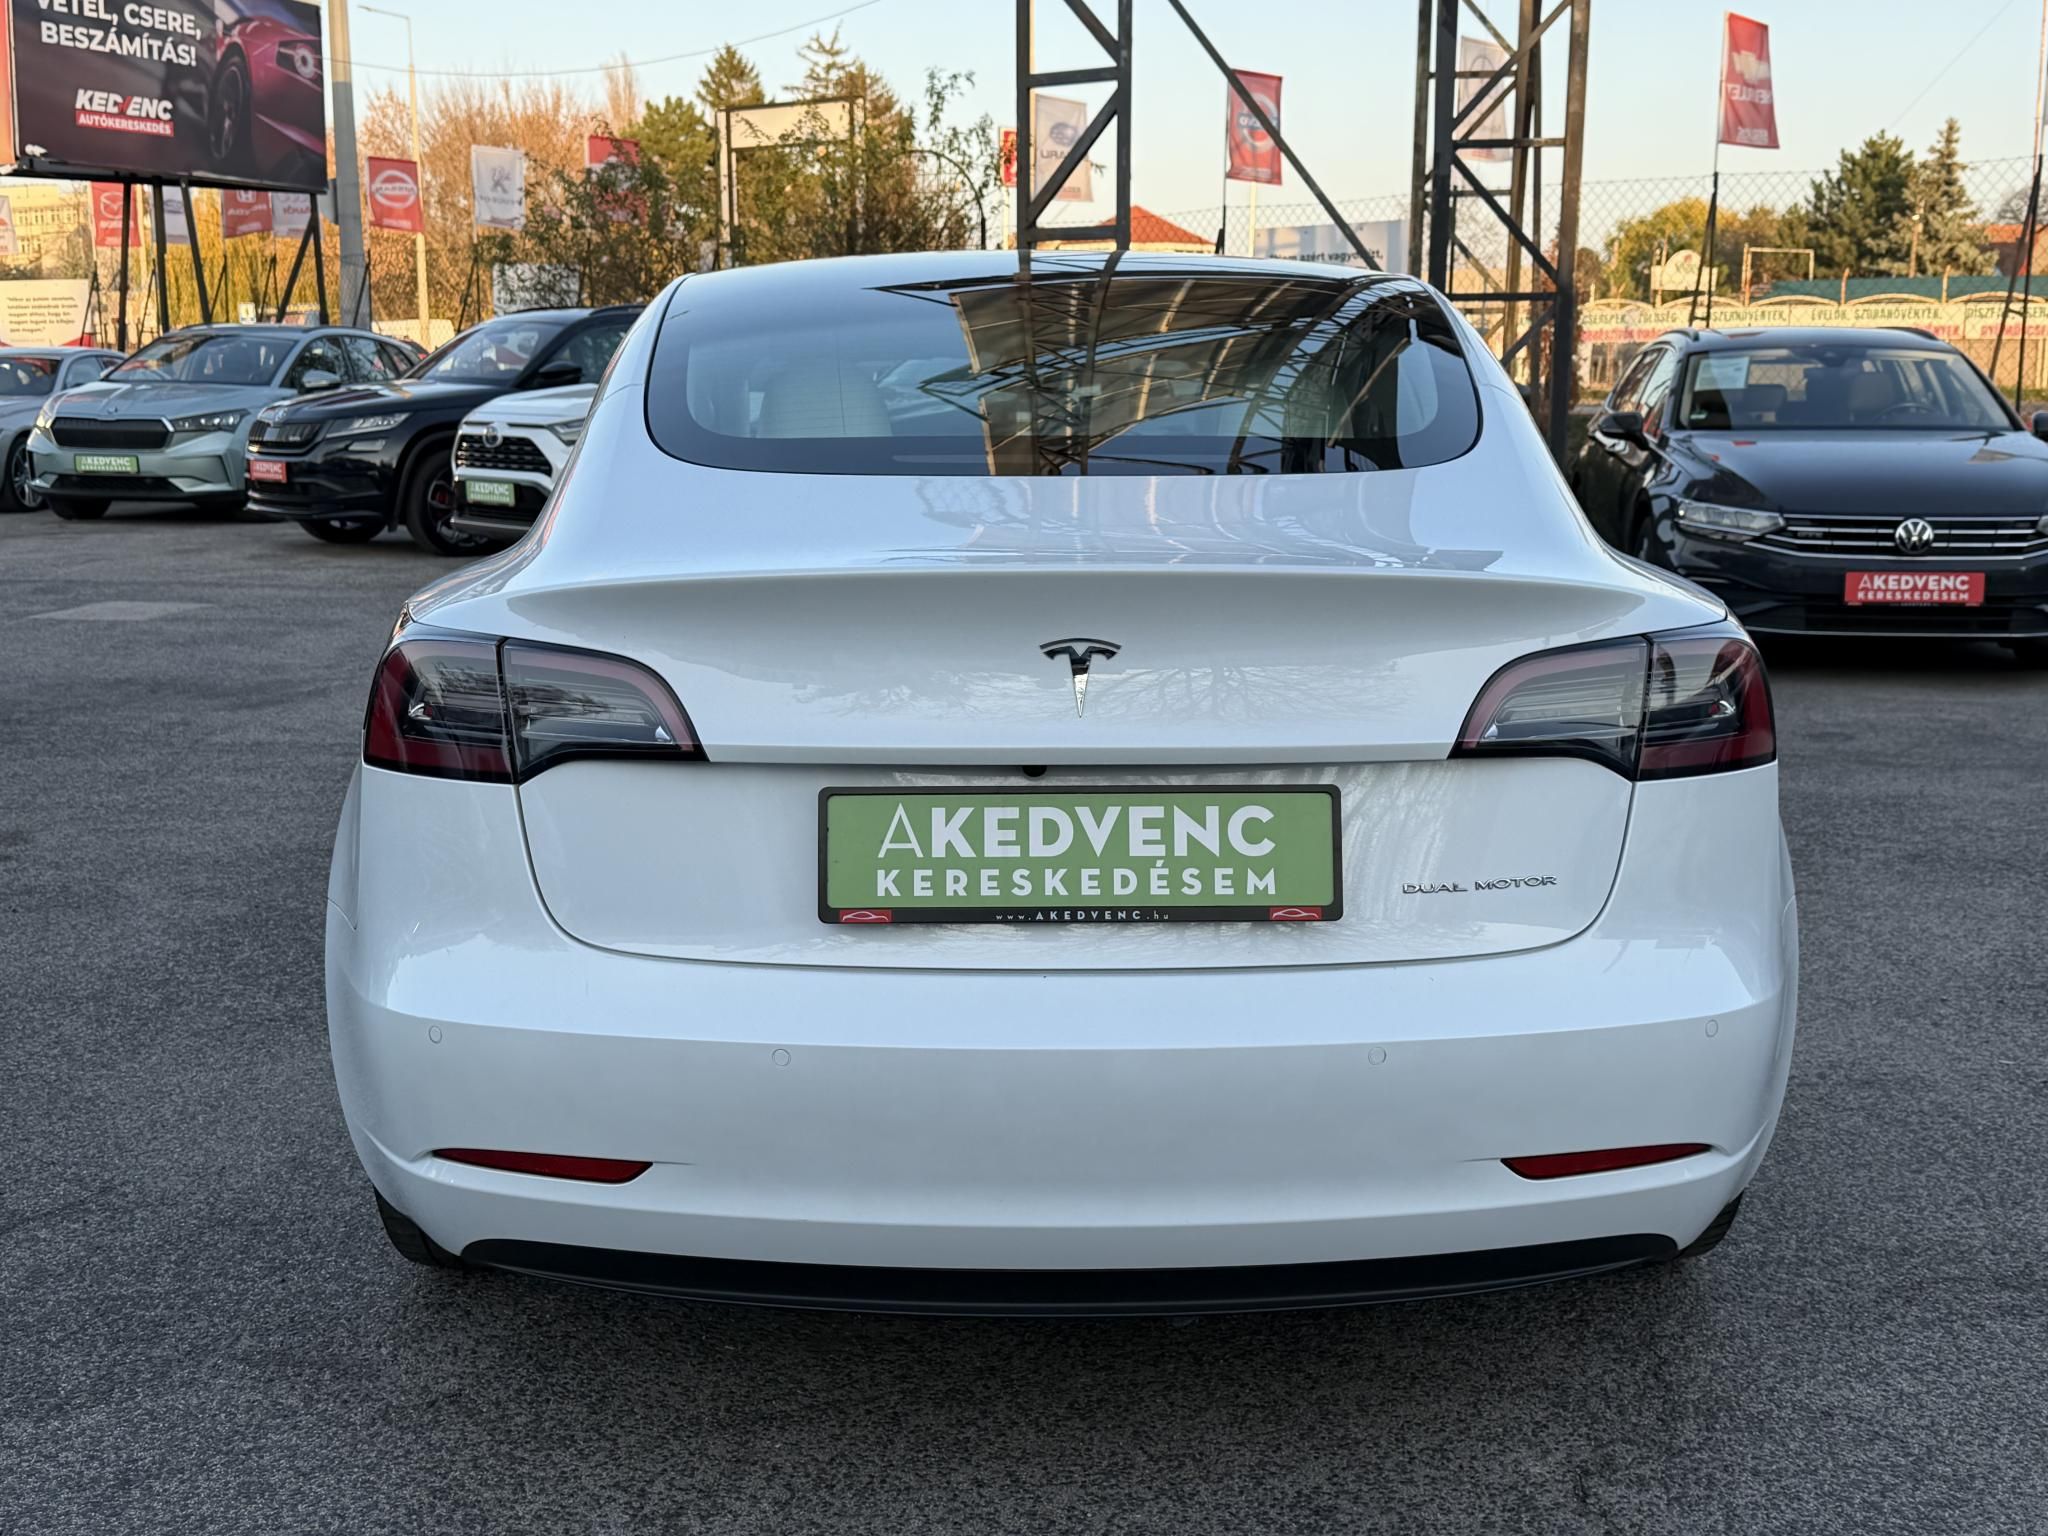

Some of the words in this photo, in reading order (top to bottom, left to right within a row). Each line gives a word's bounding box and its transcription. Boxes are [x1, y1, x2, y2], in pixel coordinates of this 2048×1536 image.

[124, 3, 201, 40] CSERE,
[41, 21, 197, 67] BESZÁMÍTÁS!
[79, 113, 171, 135] AUTÓKERESKEDÉS
[1857, 589, 1970, 601] KERESKEDÉSEM
[1858, 574, 1970, 590] AKEDVENC
[877, 802, 1276, 858] AKEDVENC
[876, 860, 1277, 897] KERESKEDÉSEM
[1403, 882, 1468, 894] DUAL
[1474, 876, 1557, 891] MOTOR
